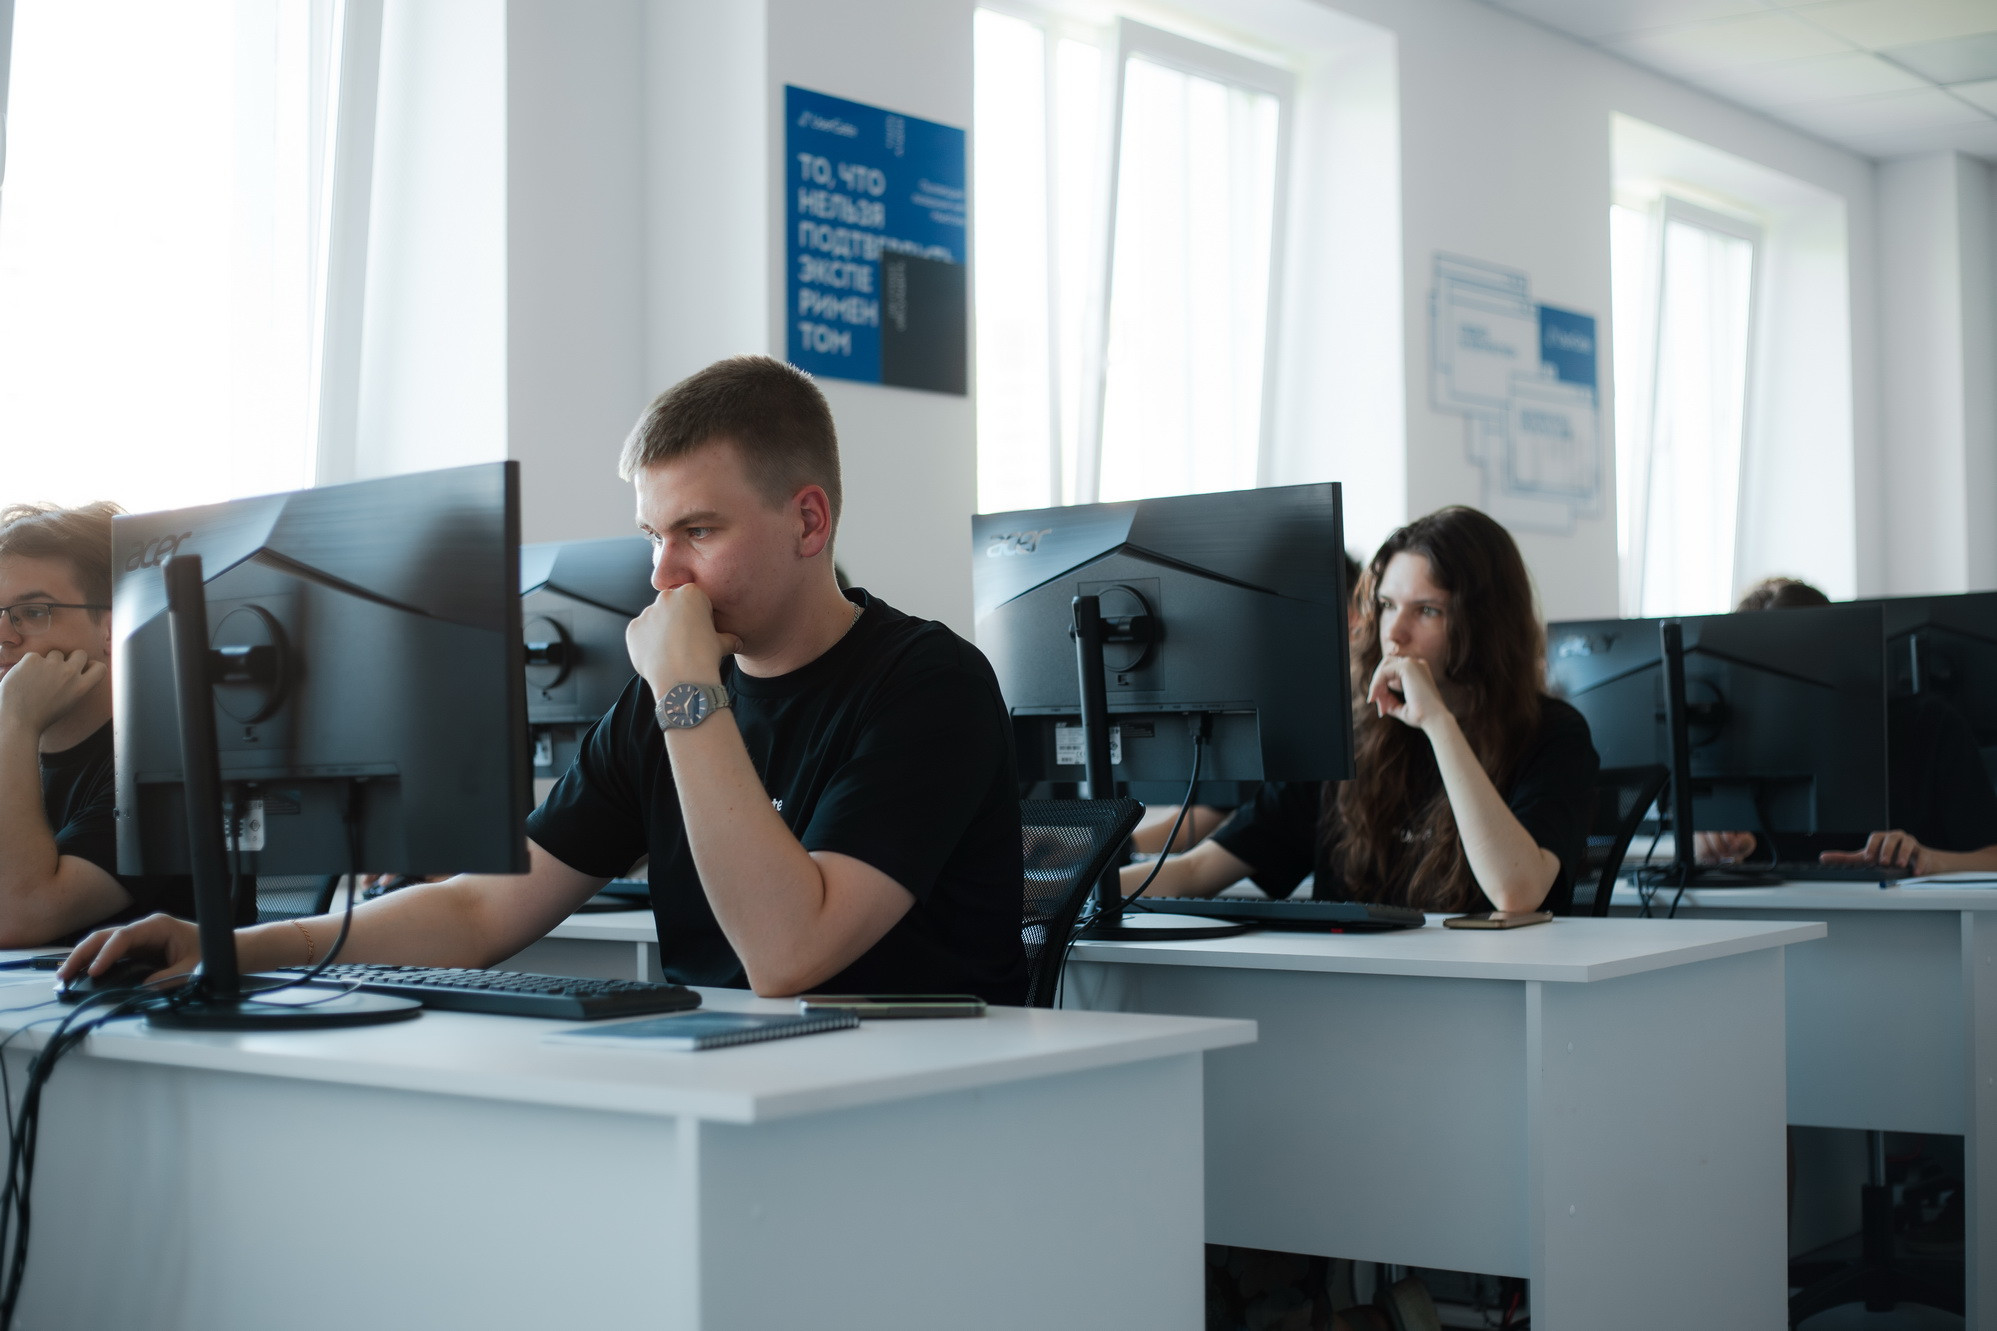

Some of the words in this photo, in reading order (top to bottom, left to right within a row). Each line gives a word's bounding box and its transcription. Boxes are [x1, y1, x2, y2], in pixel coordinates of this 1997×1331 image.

[838, 162, 886, 196] ЧТО
[798, 187, 886, 229] НЕЛЬЗЯ
[798, 254, 874, 293] ЭКСПЕ
[798, 288, 880, 327] РИМЕН
[798, 321, 852, 356] ТОМ
[986, 528, 1053, 558] acer
